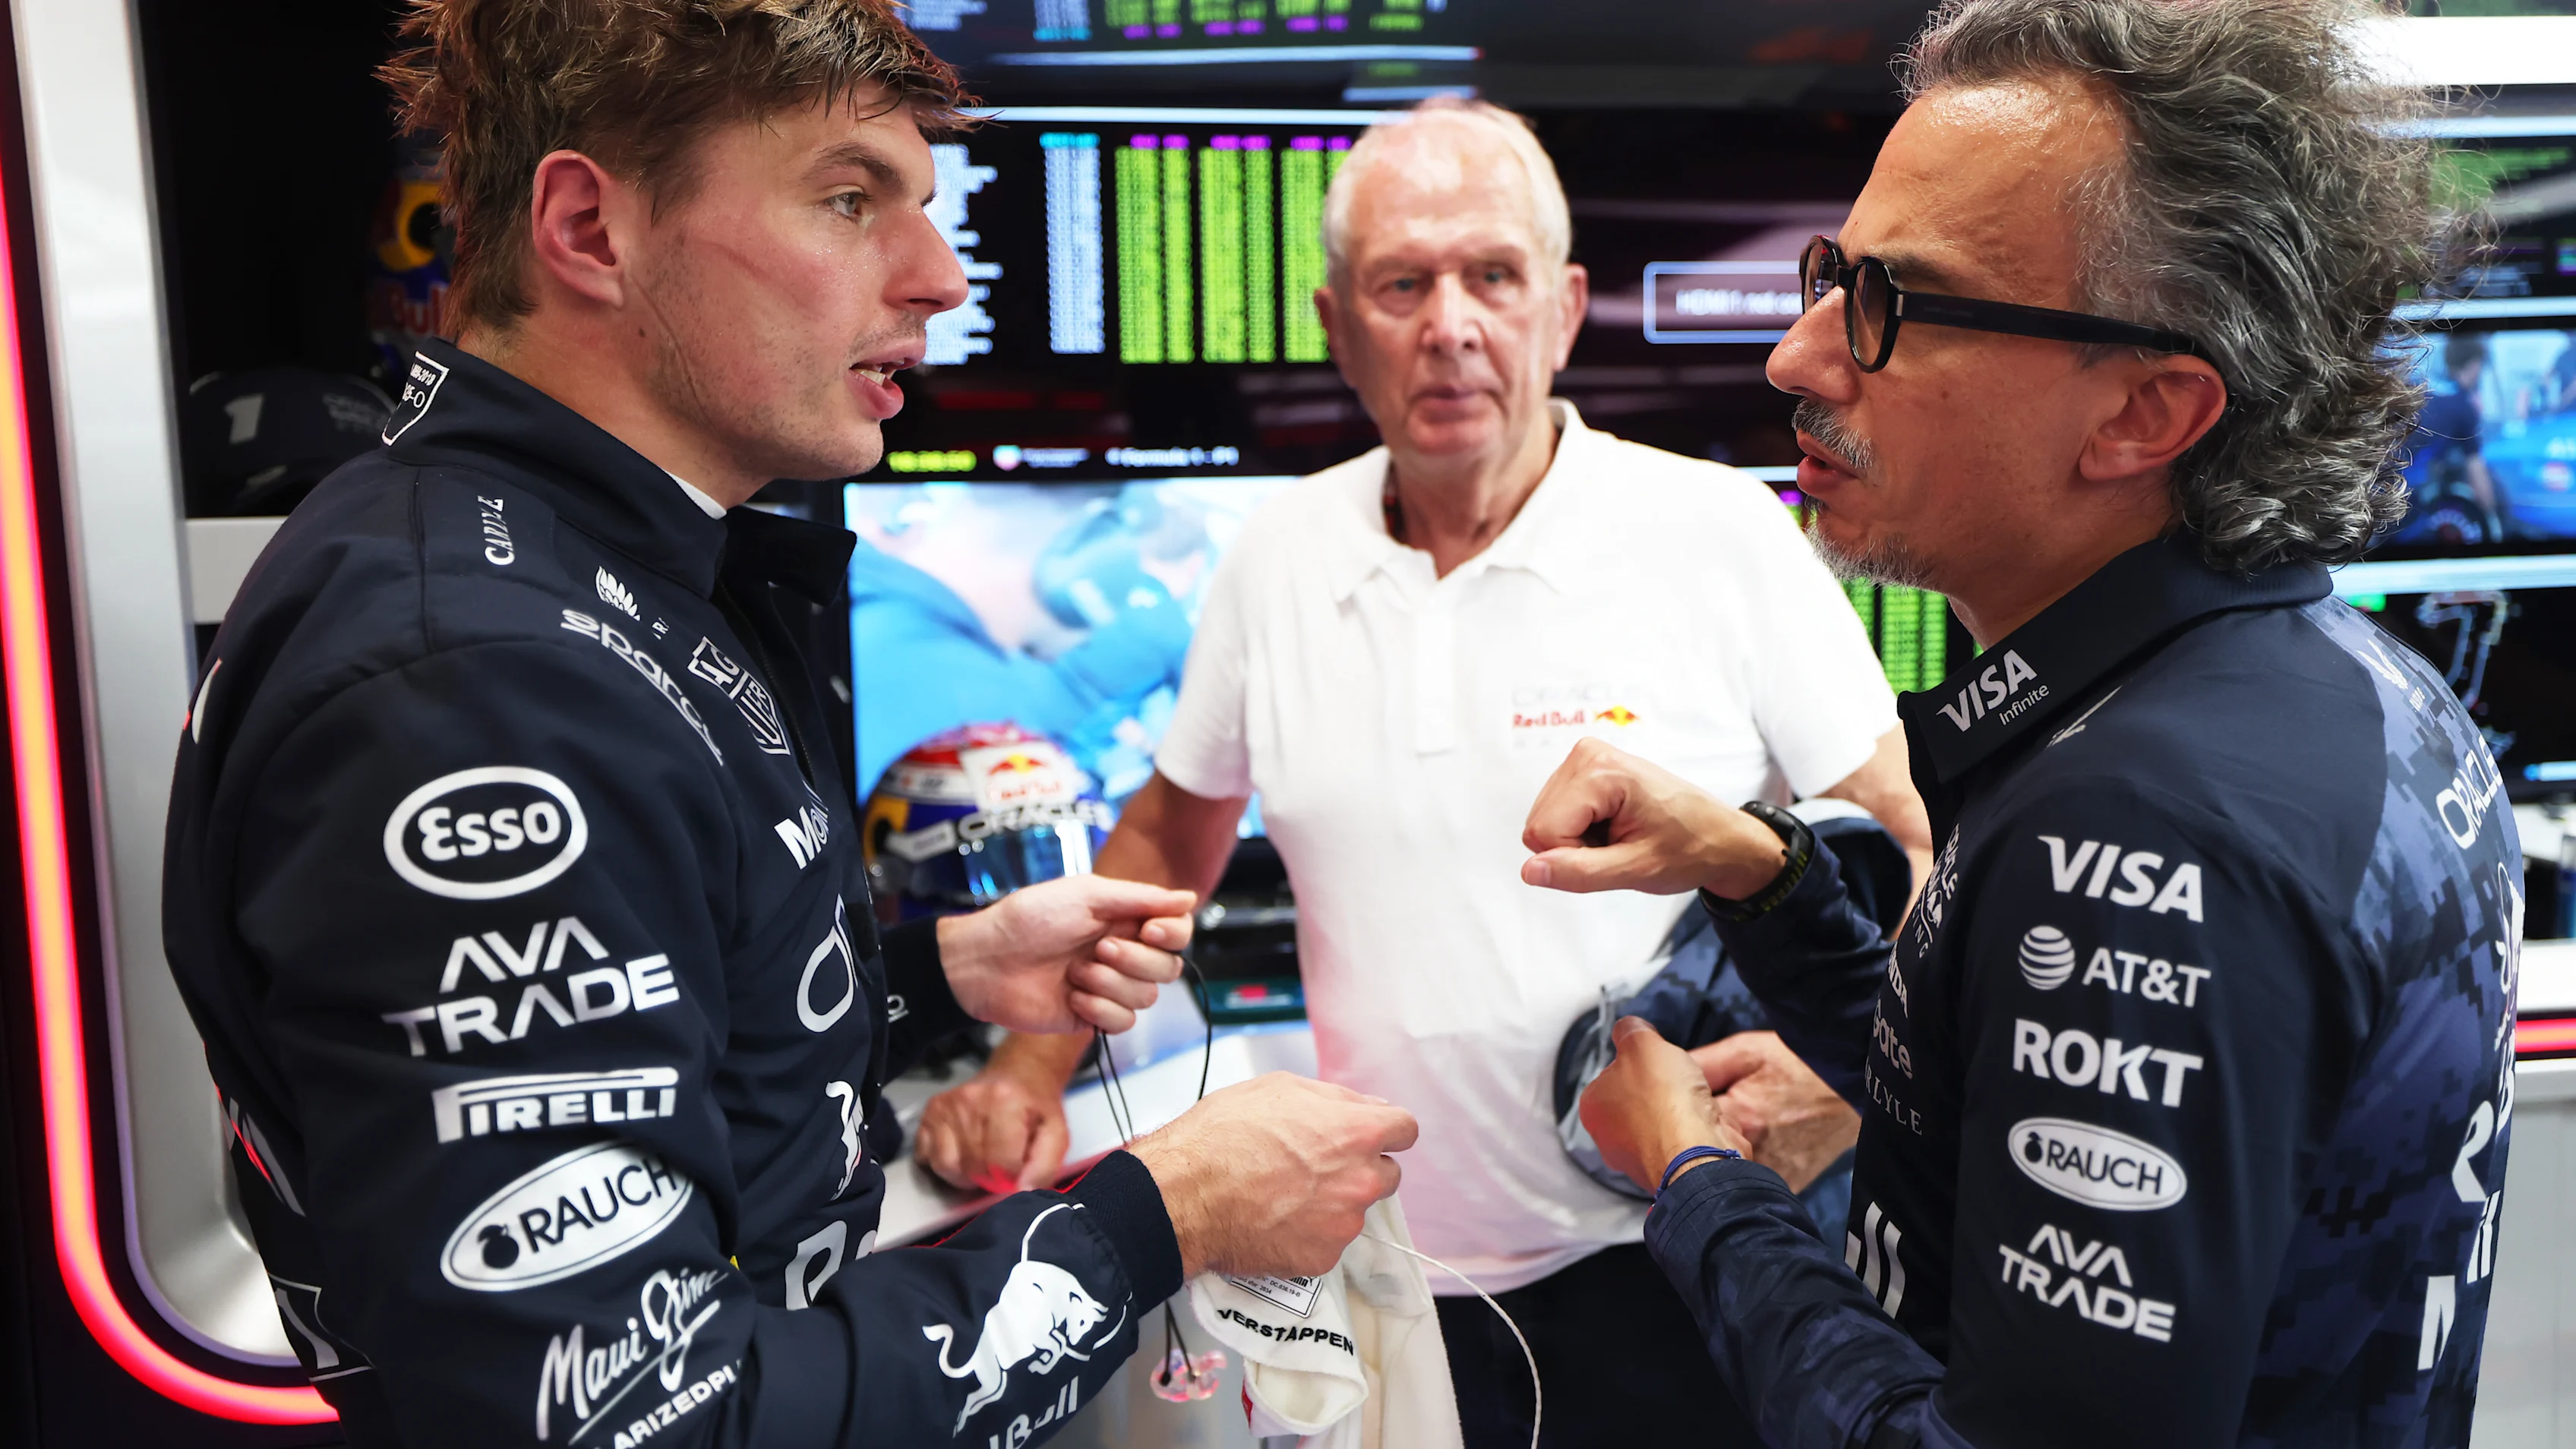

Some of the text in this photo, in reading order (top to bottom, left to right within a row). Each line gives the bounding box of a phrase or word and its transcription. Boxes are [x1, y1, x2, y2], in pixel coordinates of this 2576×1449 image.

[225, 393, 264, 444] 1
[1936, 649, 2038, 733] VISA
[1998, 684, 2050, 727] Infinite
[2038, 835, 2205, 923] VISA
[438, 916, 610, 994] AVA
[2082, 946, 2211, 1009] AT&T
[381, 952, 681, 1057] TRADE
[2012, 1018, 2204, 1108] ROKT
[431, 1066, 680, 1144] PIRELLI
[518, 1153, 679, 1254] RAUCH
[2045, 1138, 2164, 1197] RAUCH
[1998, 1245, 2177, 1343] TRADE
[2025, 1223, 2133, 1289] AVA
[1217, 1309, 1354, 1356] VERSTAPPEN
[535, 1317, 649, 1441] Maui
